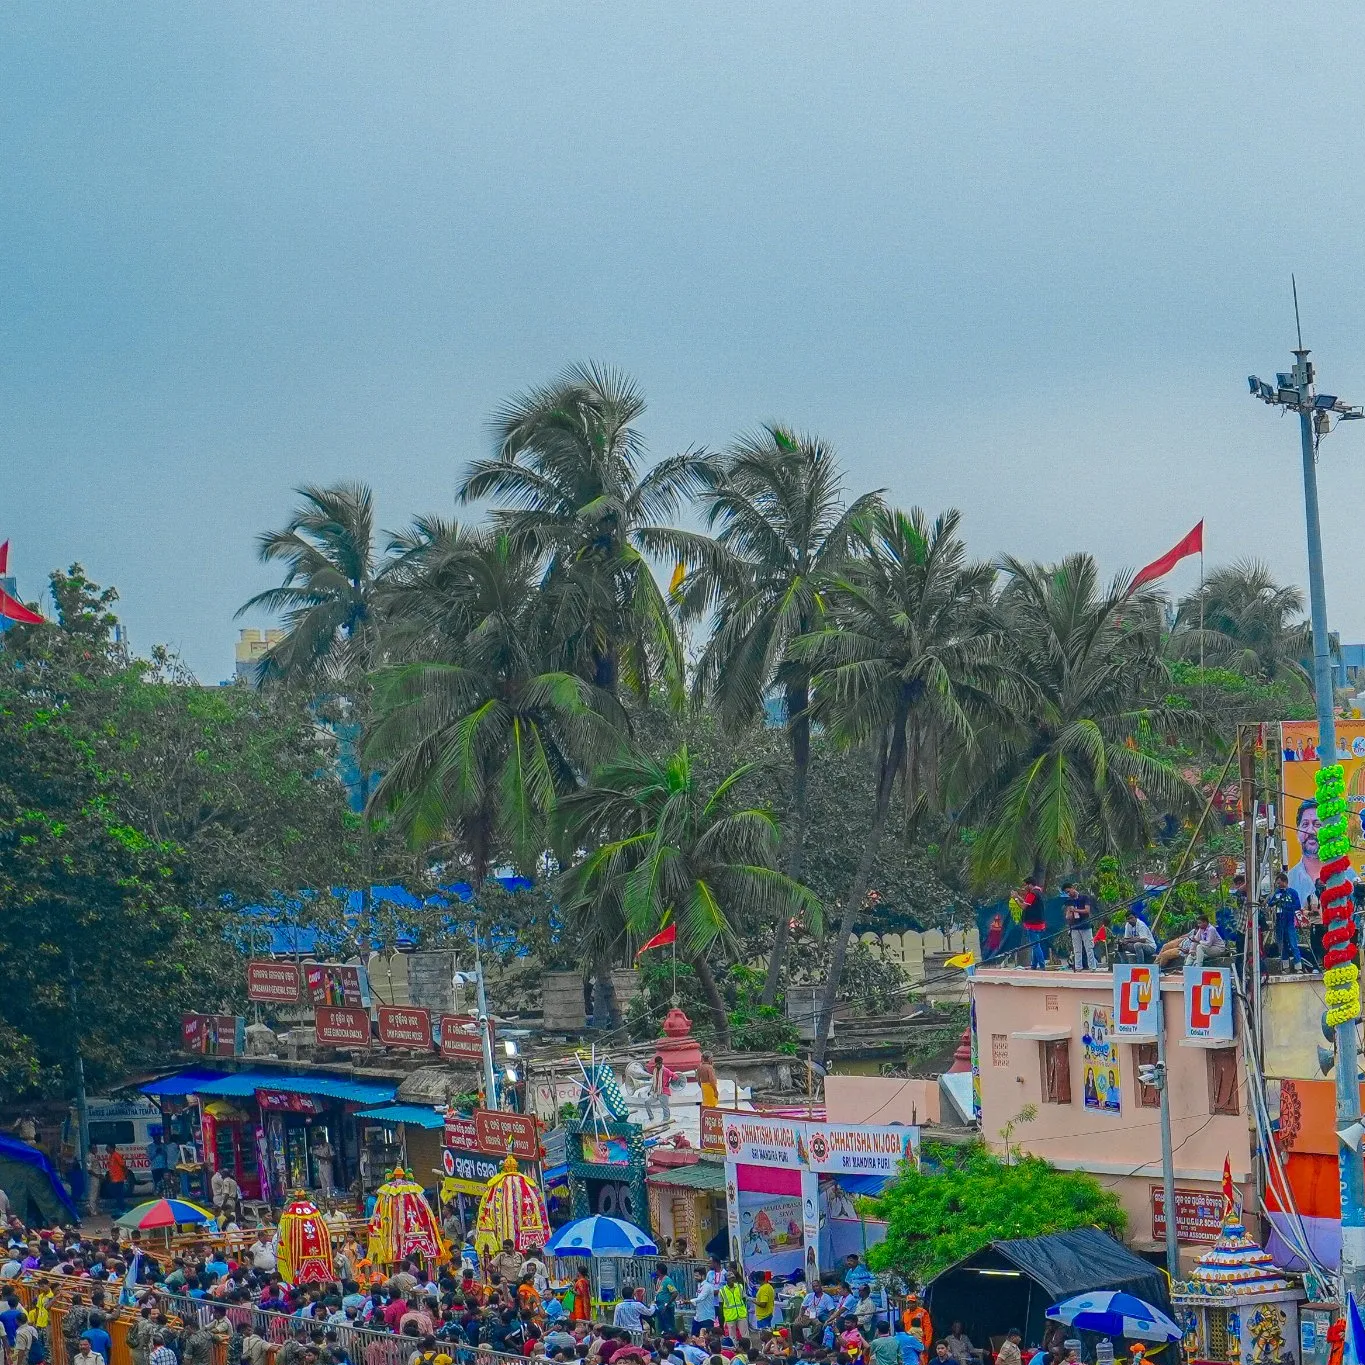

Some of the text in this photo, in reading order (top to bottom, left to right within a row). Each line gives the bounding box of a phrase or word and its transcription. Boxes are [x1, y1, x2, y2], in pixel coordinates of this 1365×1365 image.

[741, 1124, 795, 1148] CHHATISHA NIJOGA
[830, 1132, 901, 1153] CHHATISHA NIJOGA
[842, 1156, 890, 1169] SRI MANDIRA PURI
[1189, 1232, 1219, 1240] ASSOCIATIO
